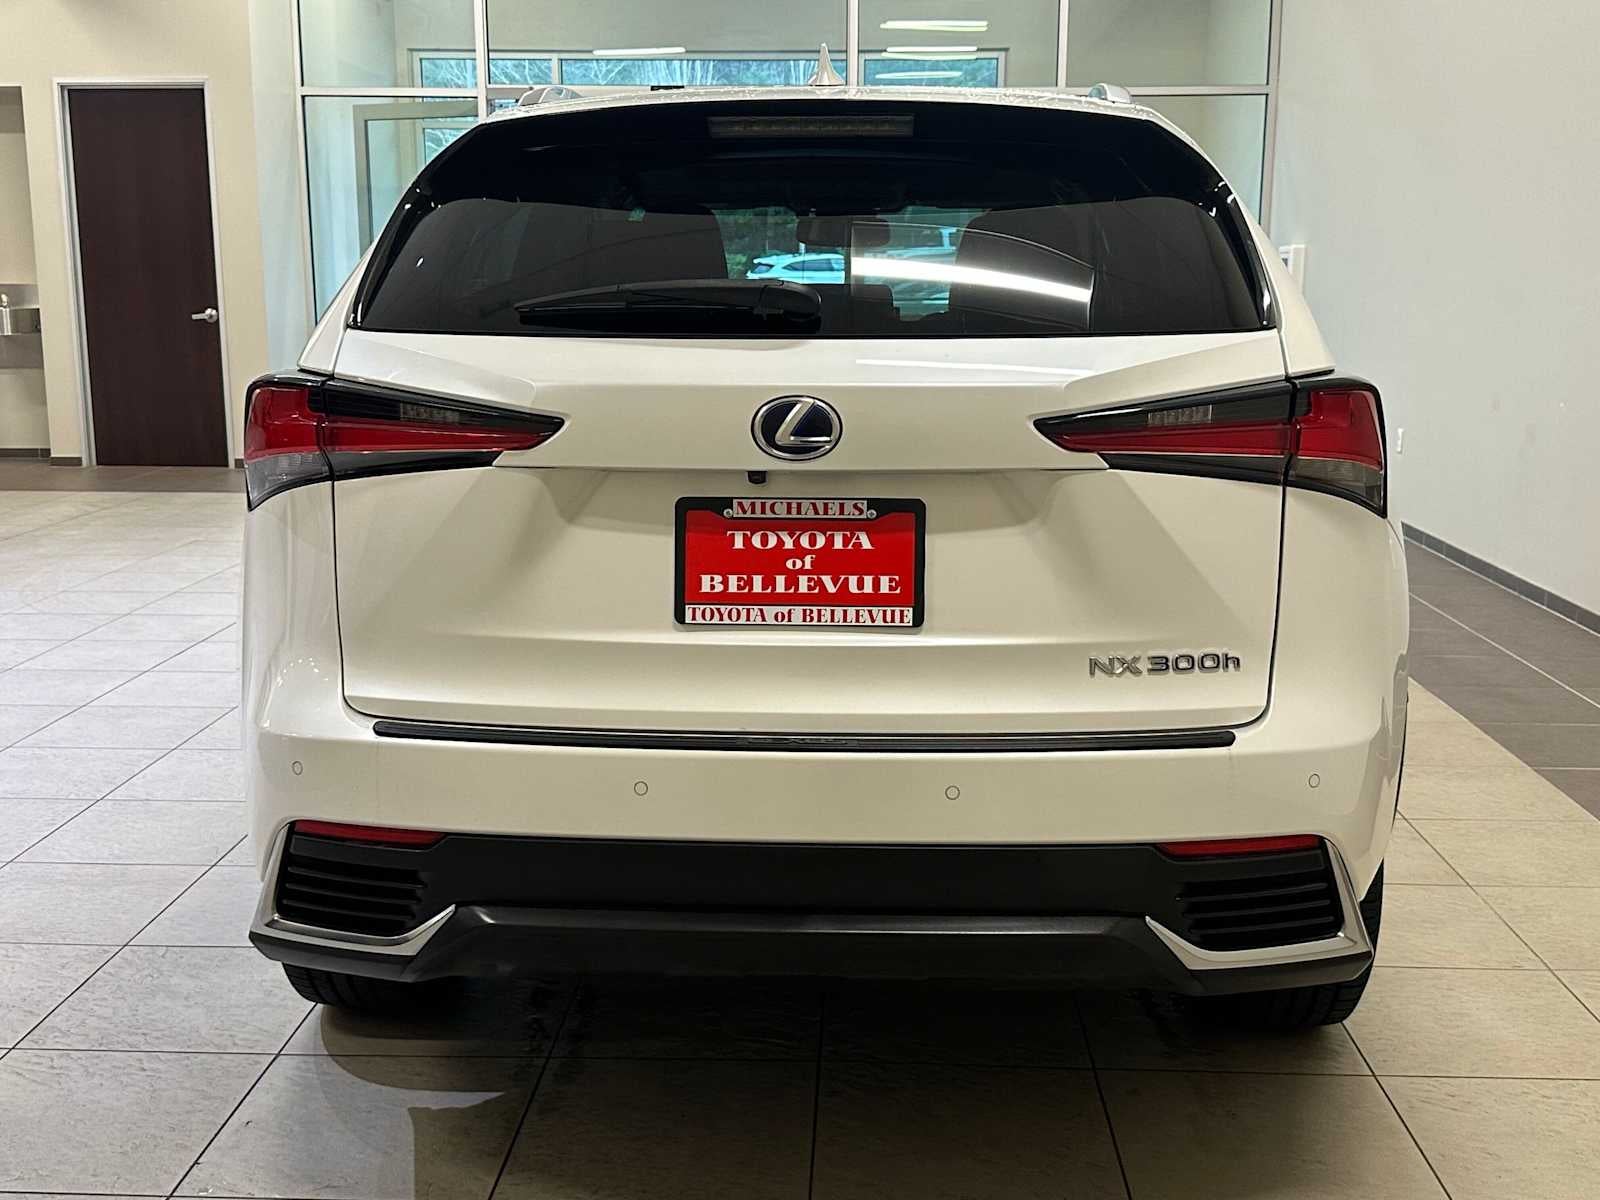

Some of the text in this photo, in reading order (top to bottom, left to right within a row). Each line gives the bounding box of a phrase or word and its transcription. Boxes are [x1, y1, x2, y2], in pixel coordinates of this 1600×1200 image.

[736, 501, 865, 516] MICHAELS
[727, 530, 875, 550] TOYOTA
[785, 554, 816, 570] of
[699, 574, 901, 594] BELLEVUE
[687, 606, 911, 625] TOYOTA of BELLEVUE
[1088, 652, 1241, 678] NX 300h
